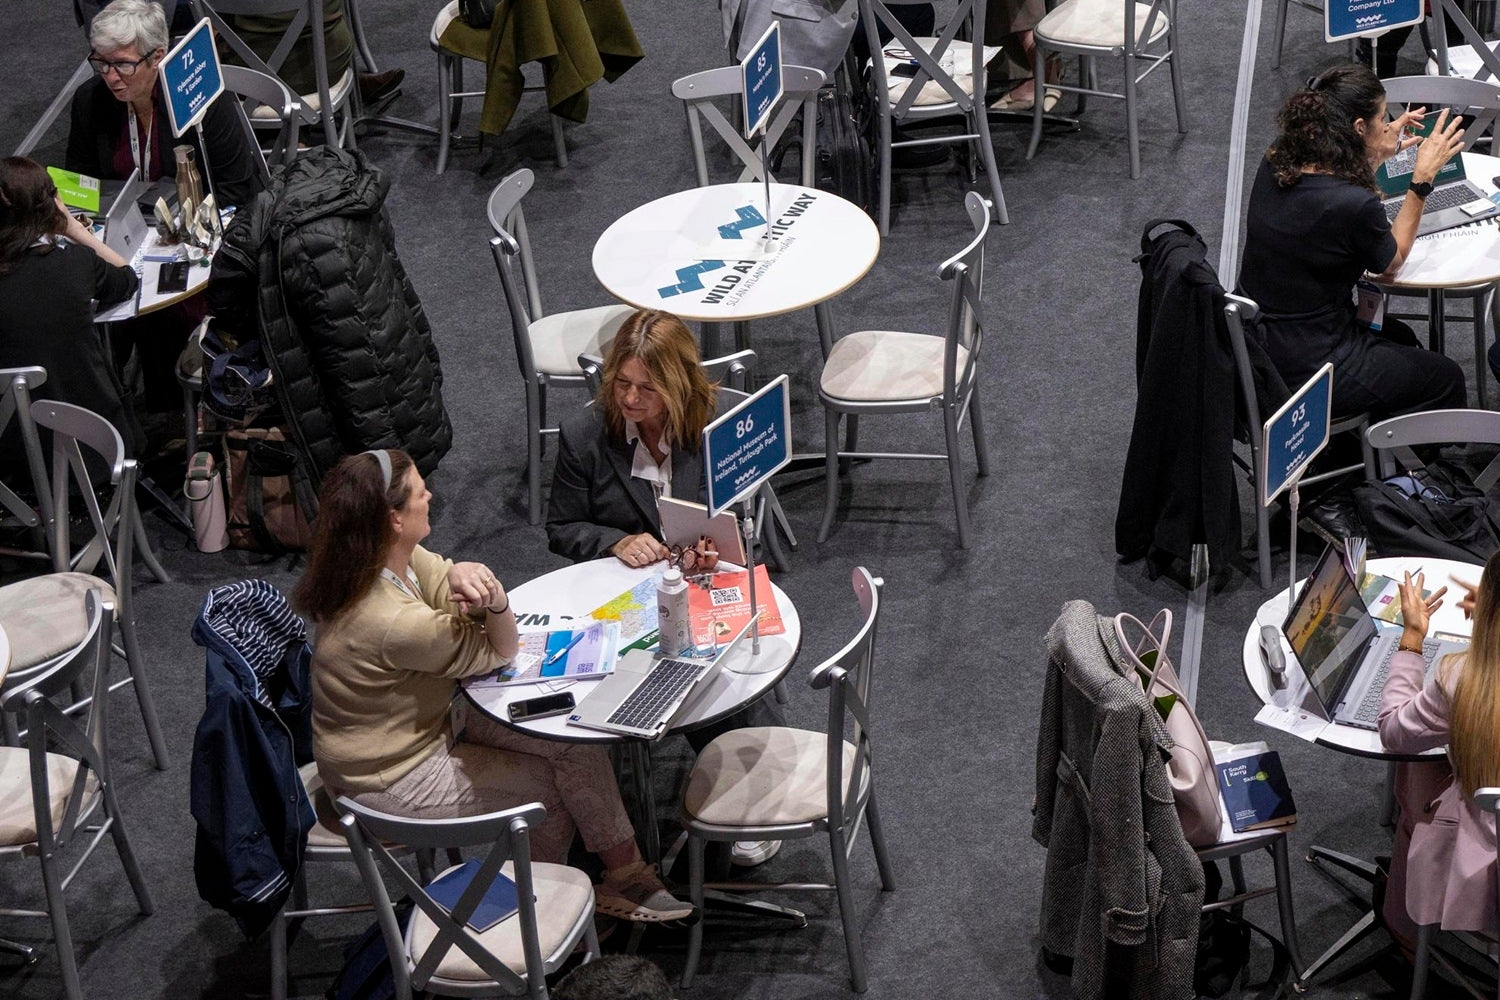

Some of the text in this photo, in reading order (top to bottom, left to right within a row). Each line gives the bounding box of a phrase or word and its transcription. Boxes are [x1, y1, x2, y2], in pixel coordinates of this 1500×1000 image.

[1348, 0, 1381, 12] Company
[182, 49, 194, 70] 72
[194, 60, 206, 75] Abbey
[757, 51, 766, 72] 85
[189, 75, 203, 92] Garden
[701, 193, 817, 305] WILD WAY
[1292, 402, 1305, 426] 93
[736, 415, 753, 438] 86
[717, 423, 775, 470] National Museum of
[1291, 434, 1304, 452] Hotel
[715, 435, 777, 483] Ireland, Turlough Park
[1228, 764, 1247, 772] South
[1230, 769, 1247, 777] Kerry
